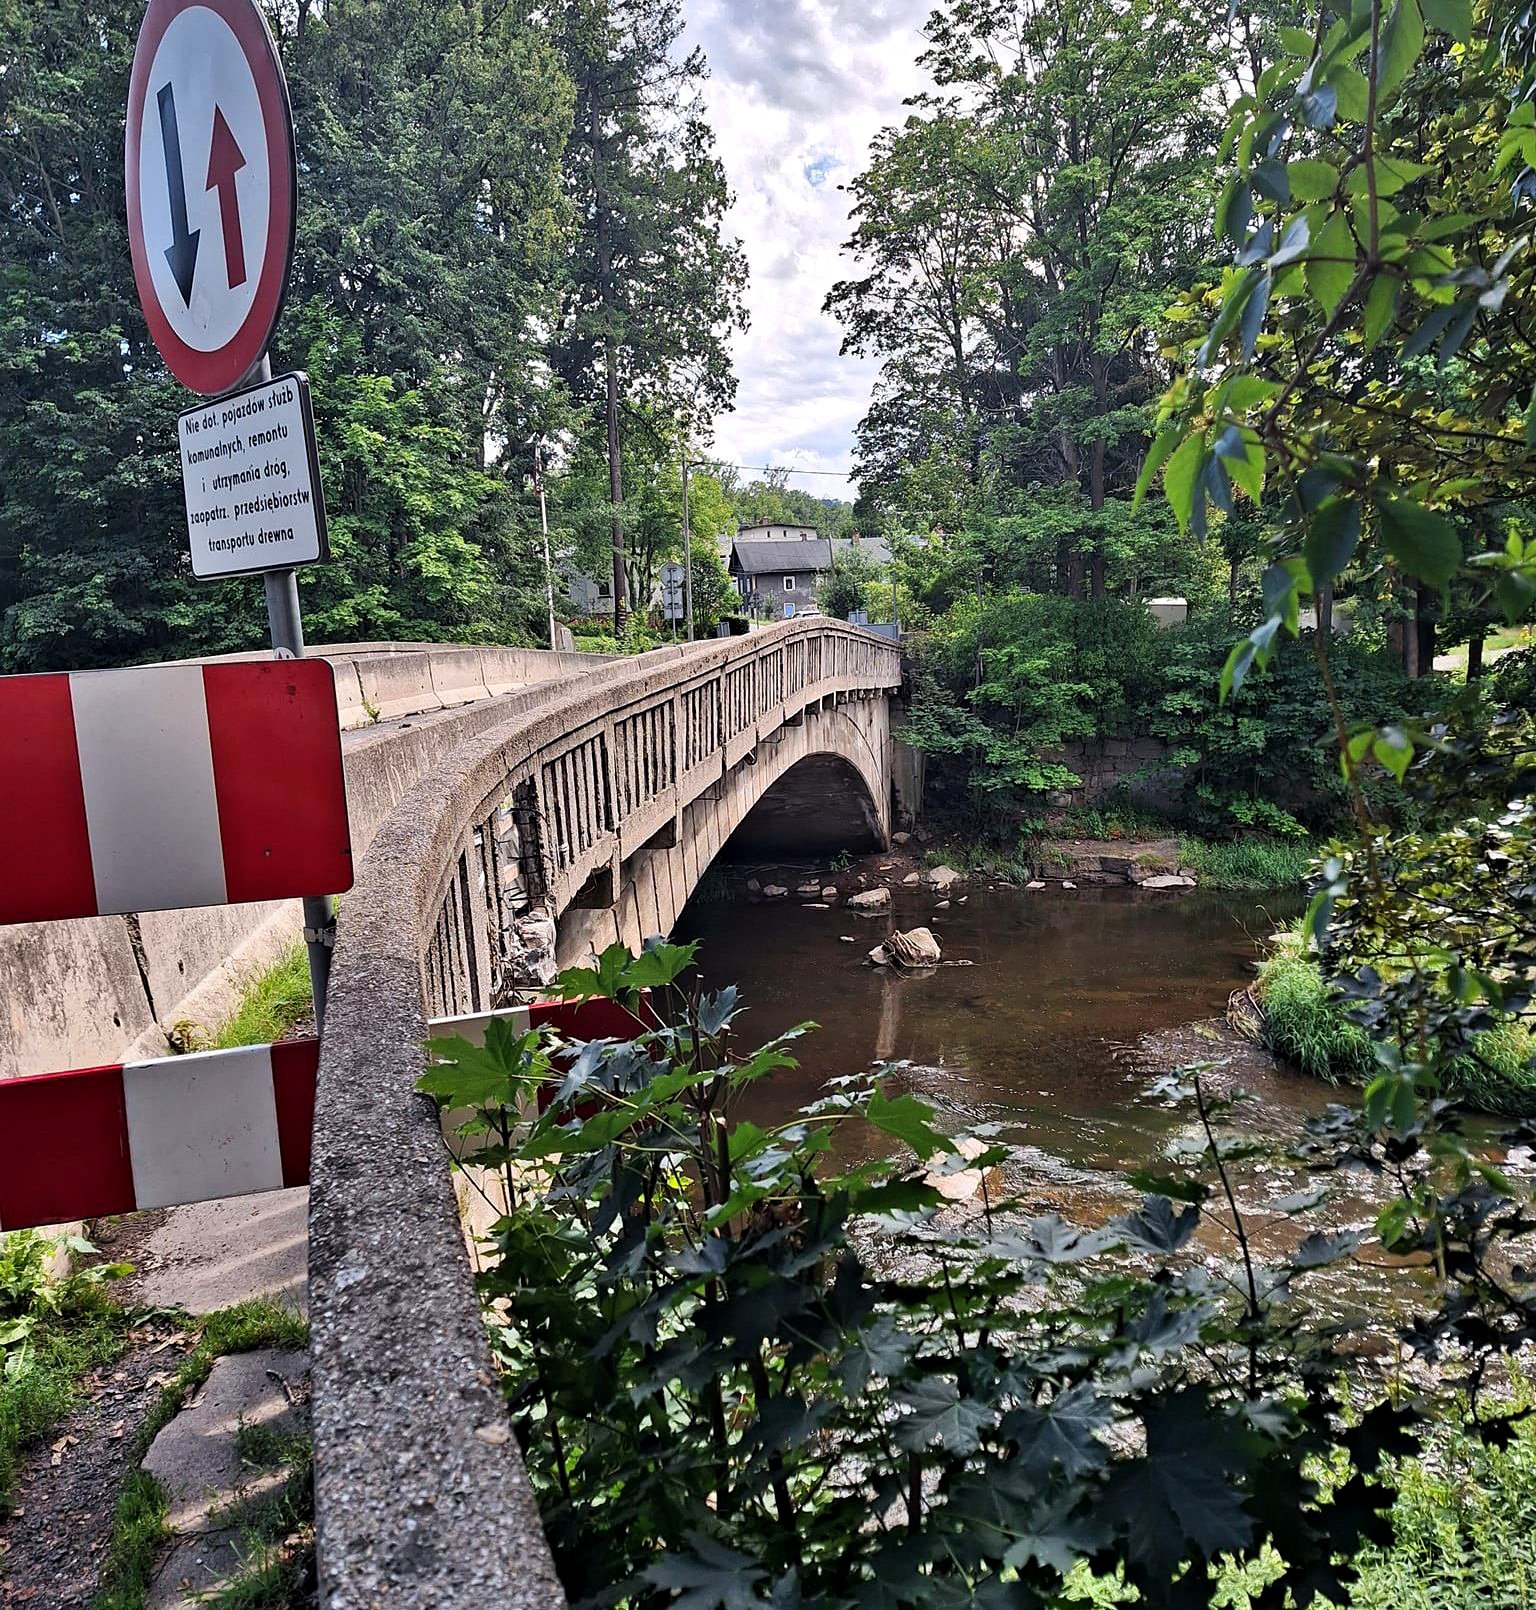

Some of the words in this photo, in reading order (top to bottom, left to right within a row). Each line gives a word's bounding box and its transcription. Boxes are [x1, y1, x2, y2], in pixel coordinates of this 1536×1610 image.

[186, 417, 199, 435] Nie
[202, 412, 219, 430] dot.
[222, 396, 265, 428] pojazdów
[268, 386, 294, 409] służb
[187, 436, 246, 465] komunalnych,
[248, 424, 288, 447] remontu
[202, 477, 205, 492] i
[213, 465, 260, 490] utrzymania
[264, 457, 290, 478] dróg,
[191, 507, 230, 527] zaopatrz.
[235, 489, 310, 520] przedsiębiorstw
[208, 531, 255, 553] transportu
[258, 527, 294, 544] drewna
